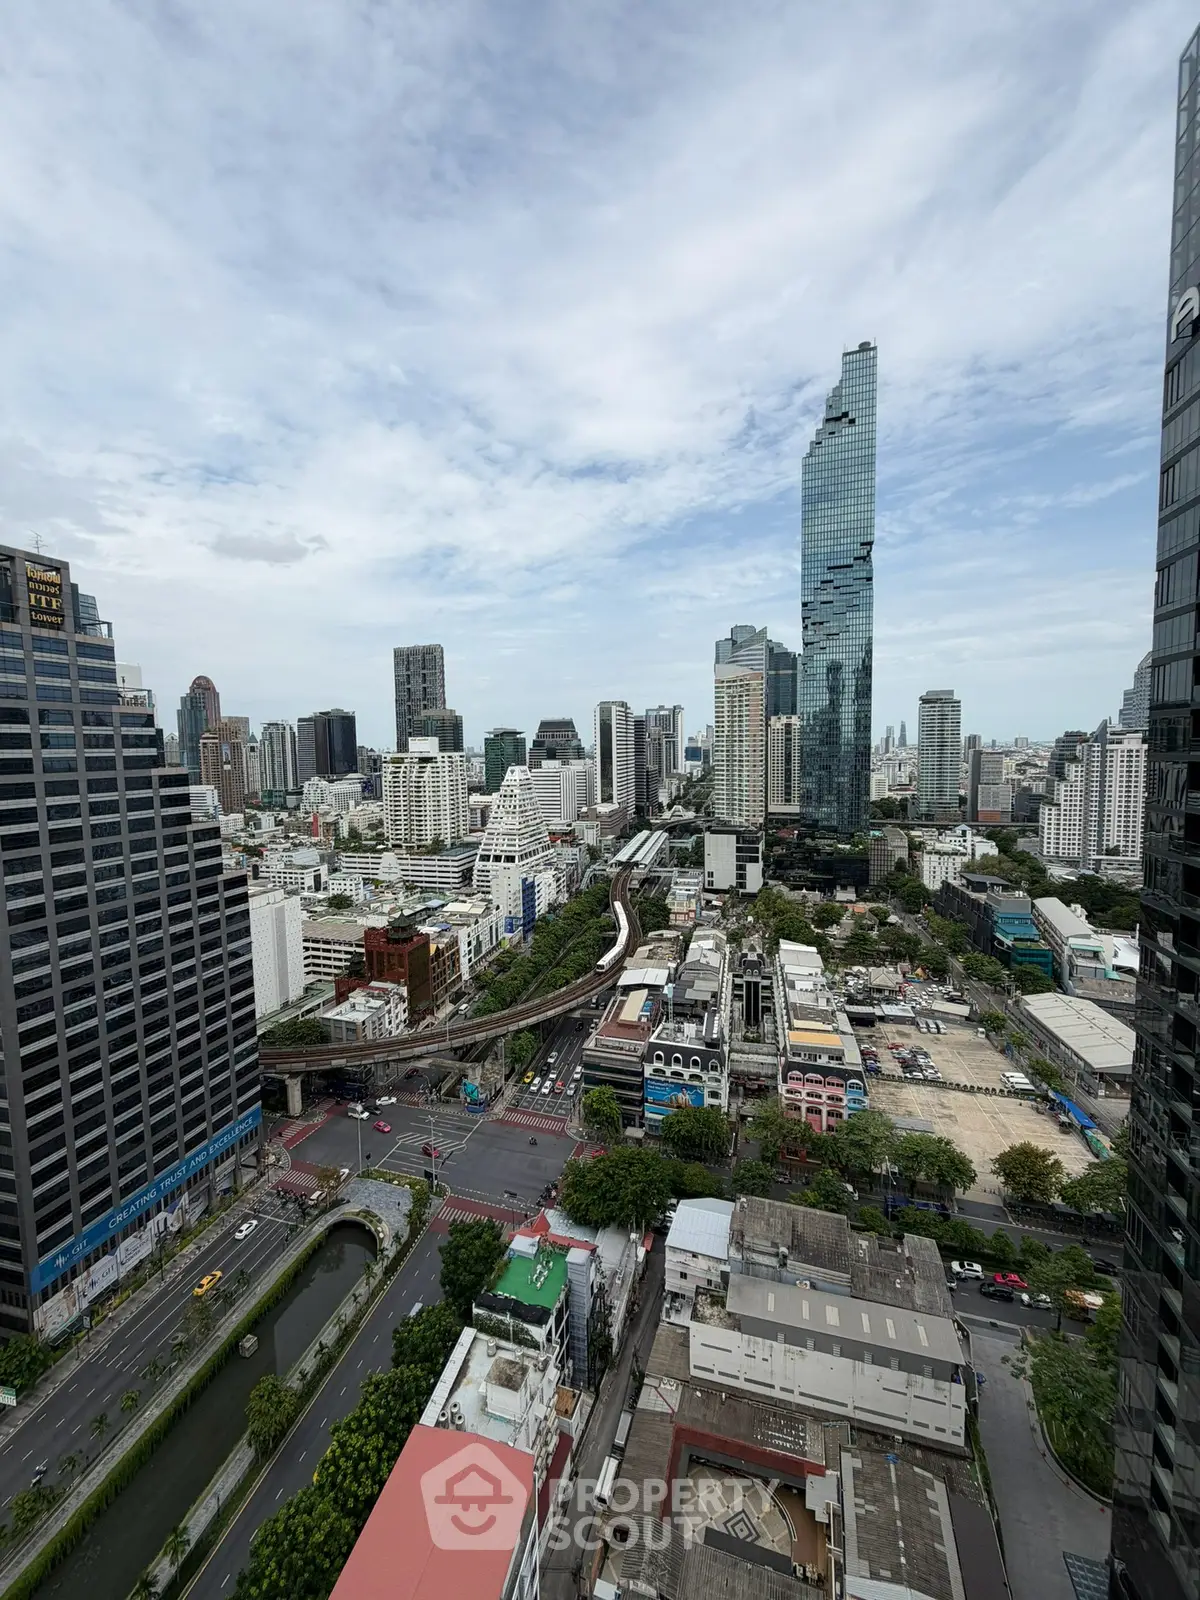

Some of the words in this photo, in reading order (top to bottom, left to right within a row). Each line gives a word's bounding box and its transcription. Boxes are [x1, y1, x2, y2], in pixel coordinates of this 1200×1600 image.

[29, 592, 62, 610] ITF
[31, 611, 63, 624] tower
[108, 1188, 157, 1229] CREATING
[159, 1167, 187, 1190] TRUST
[189, 1151, 208, 1170] AND
[209, 1116, 253, 1154] EXCELLENCE
[71, 1238, 89, 1256] GIT
